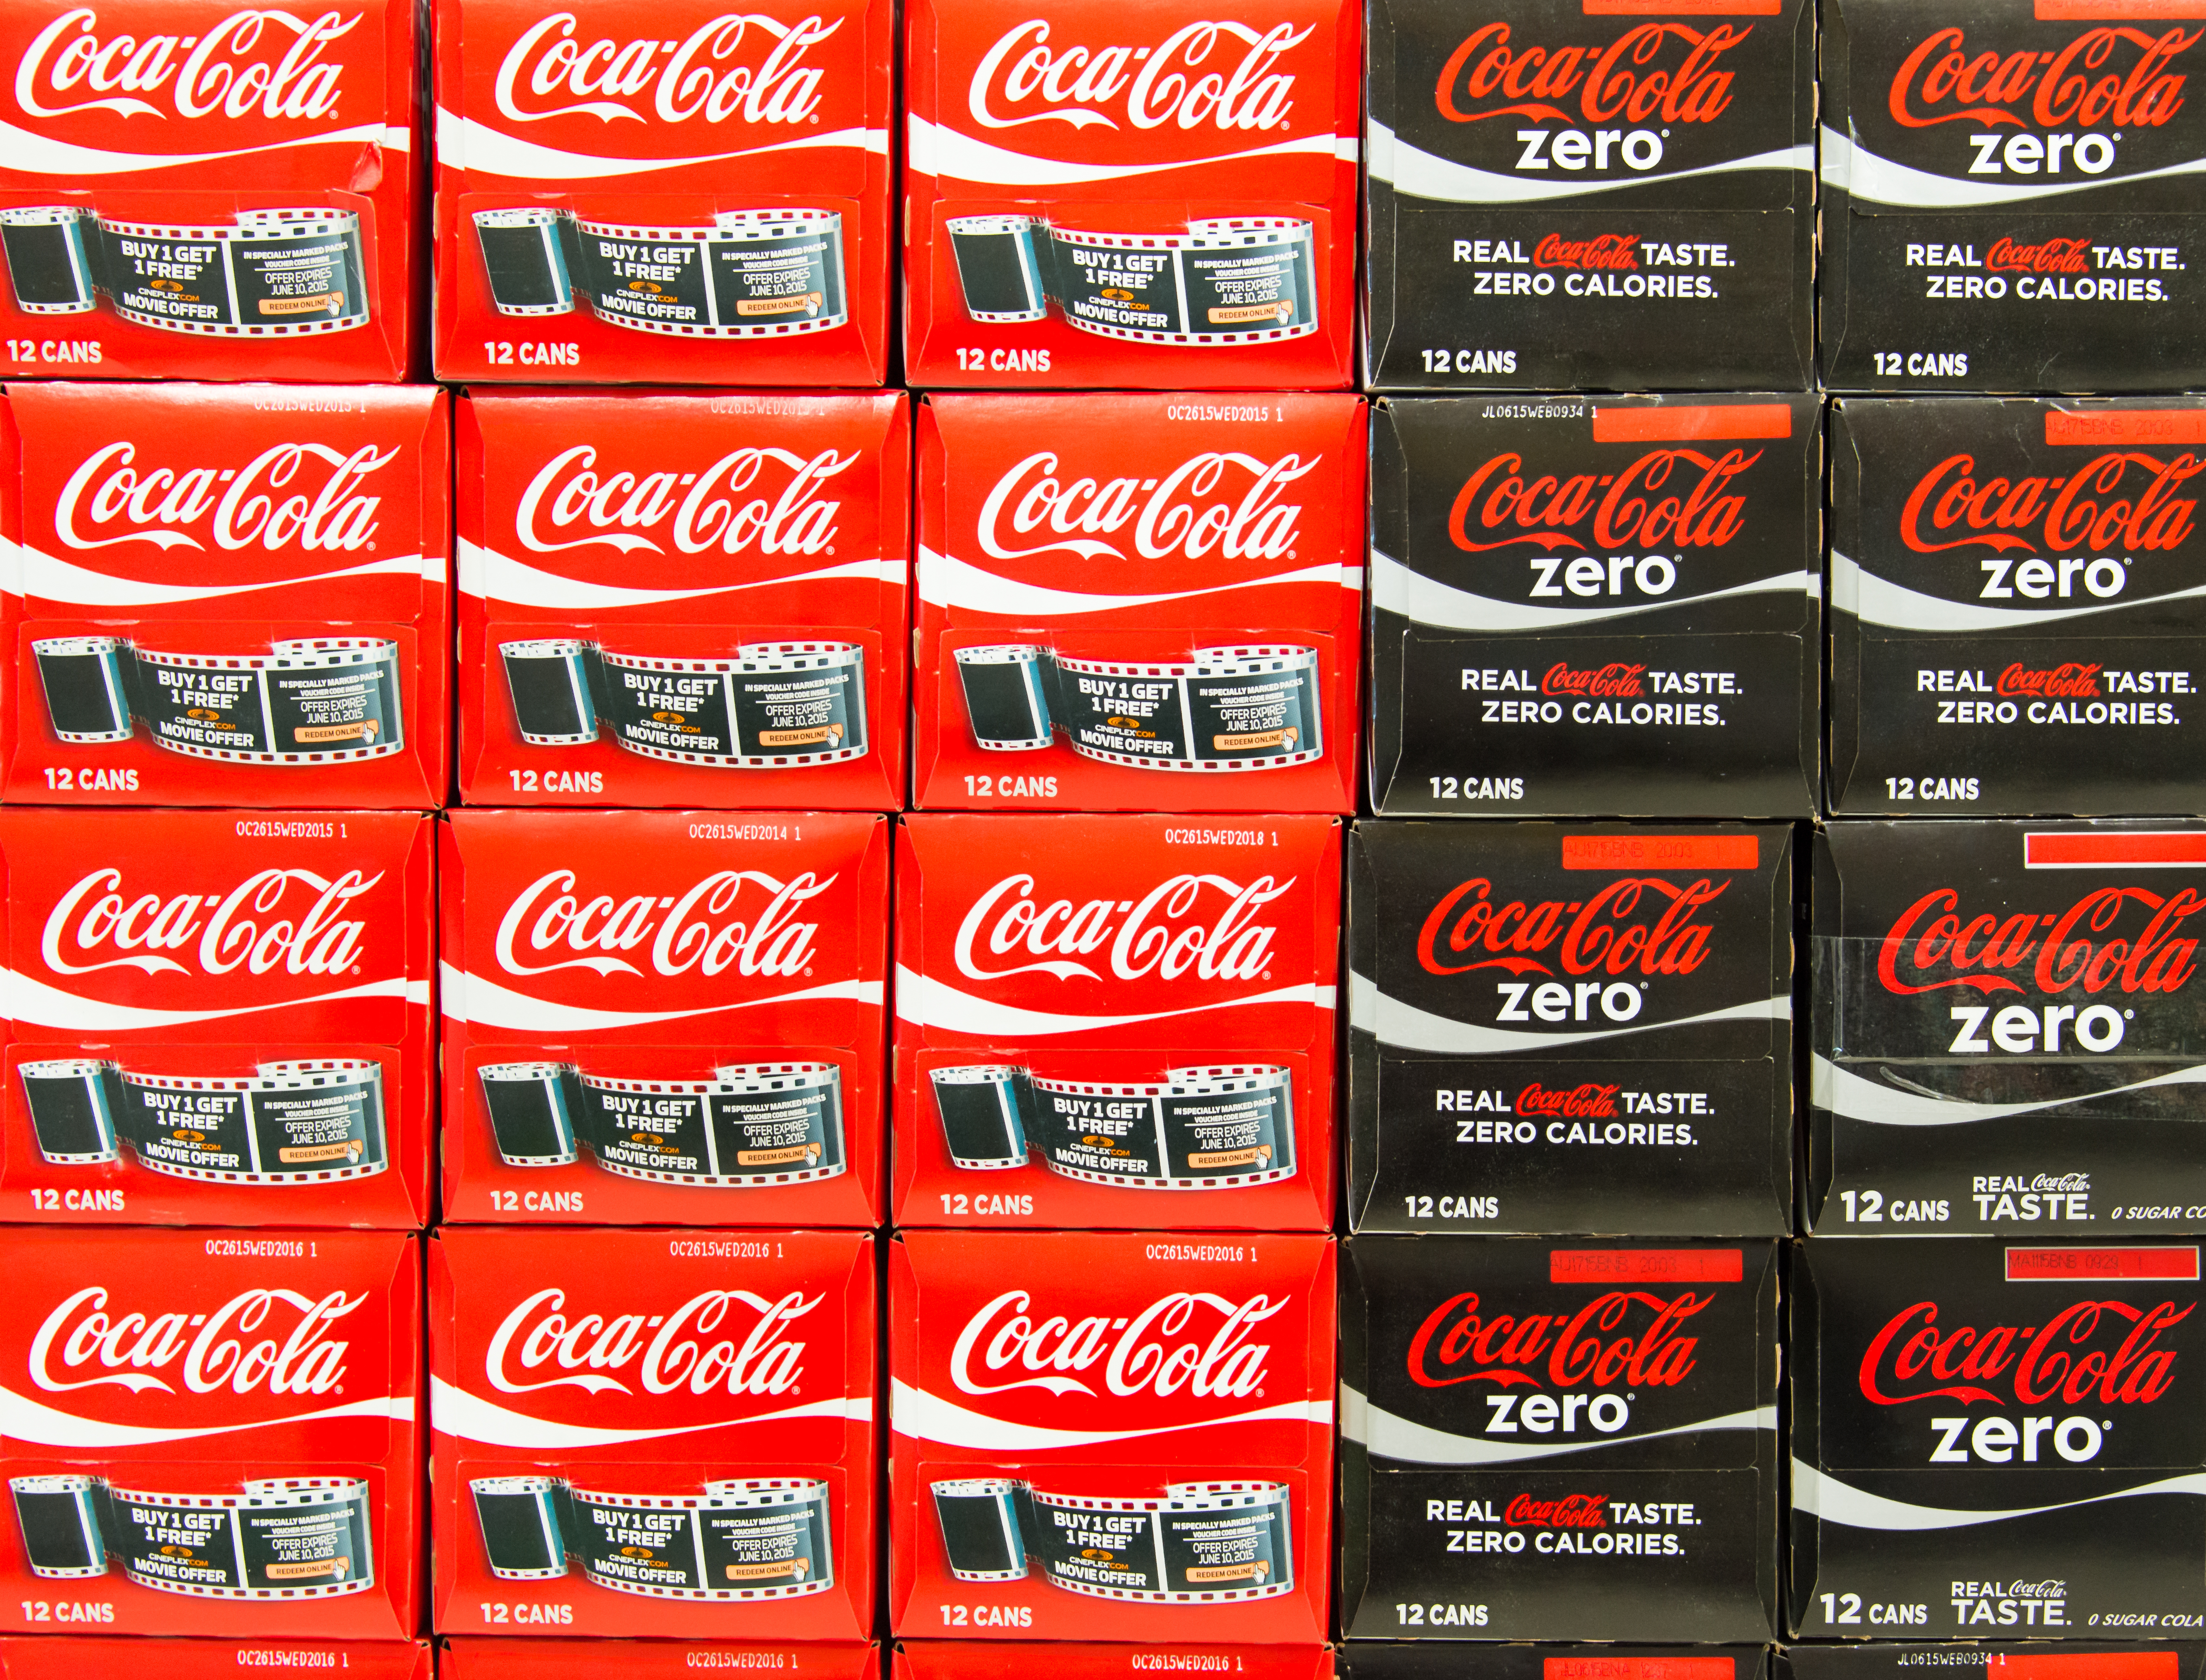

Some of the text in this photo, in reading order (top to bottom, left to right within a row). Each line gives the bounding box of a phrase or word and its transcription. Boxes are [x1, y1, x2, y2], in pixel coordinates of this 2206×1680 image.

[16, 7, 363, 119] Coca-Cola
[496, 13, 844, 124] Coca-Cola
[1435, 22, 1754, 124] Coca-Cola
[969, 20, 1316, 130] Coca-Cola
[1888, 27, 2205, 129] Coca-Cola
[1515, 130, 1664, 169] zero
[1969, 134, 2114, 173] zero
[1454, 241, 1529, 262] REAL
[1641, 243, 1735, 266] TASTE.
[1474, 273, 1717, 298] ZERO CALORIES.
[7, 340, 101, 363] 12 CANS
[957, 348, 1050, 371] 12 CANS
[1874, 353, 1967, 376] 12 CANS
[1276, 406, 1283, 422] 1
[1592, 406, 1598, 418] 1
[56, 442, 400, 551] Coca-Cola
[516, 445, 861, 554] Coca-Cola
[978, 452, 1322, 560] Coca-Cola
[1449, 449, 1763, 552] Coca-Cola
[1900, 452, 2206, 553] Coca-Cola
[1529, 555, 1677, 596] zero
[1980, 558, 2125, 598] zero
[1079, 678, 1173, 700] BUY 1 GET
[1208, 687, 1247, 696] SPECIALLY
[1247, 683, 1279, 694] MARKED
[1280, 677, 1304, 689] PACKS
[1918, 671, 1992, 691] REAL
[2104, 671, 2196, 693] TASTE.
[1092, 697, 1101, 711] 1
[1265, 691, 1285, 701] INSIDE
[1220, 703, 1286, 720] OFFER EXPIRES
[1227, 720, 1249, 731] JUNE
[1263, 715, 1283, 729] 2015
[1938, 702, 2179, 724] ZERO CALORIES.
[1080, 729, 1173, 754] MOVIE OFFER
[1255, 735, 1280, 743] ONLINE
[510, 770, 602, 793] 12 CANS
[1430, 777, 1523, 799] 12 CANS
[340, 823, 347, 838] 1
[795, 826, 801, 840] 1
[1272, 831, 1279, 847] 1
[42, 868, 384, 975] Coca-Cola
[496, 870, 838, 977] Coca-Cola
[955, 874, 1296, 981] Coca-Cola
[1417, 878, 1731, 976] Coca-Cola
[1878, 887, 2206, 995] Coca-Cola
[1496, 983, 1642, 1021] zero
[1949, 1005, 2123, 1053] zero
[144, 1092, 238, 1113] BUY 1 GET
[273, 1100, 311, 1109] SPECIALLY
[312, 1096, 343, 1107] MARKED
[344, 1090, 368, 1102] PACKS
[1437, 1090, 1511, 1111] REAL
[1622, 1093, 1714, 1114] TASTE.
[157, 1110, 167, 1125] 1
[285, 1109, 313, 1118] VOUCHER
[330, 1105, 349, 1114] INSIDE
[286, 1116, 351, 1133] OFFER EXPIRES
[292, 1133, 313, 1144] JUNE
[328, 1128, 348, 1141] 2015
[1457, 1121, 1697, 1145] ZERO CALORIES.
[146, 1142, 239, 1167] MOVIE OFFER
[320, 1147, 345, 1156] ONLINE
[1974, 1176, 2029, 1192] REAL
[940, 1194, 1033, 1215] 12 CANS
[1841, 1191, 1949, 1222] 12 CANS
[1973, 1194, 2095, 1220] TASTE.
[2126, 1206, 2181, 1219] SUGAR
[2186, 1206, 2206, 1218] CO
[311, 1242, 317, 1257] 1
[777, 1243, 783, 1258] 1
[1251, 1247, 1257, 1262] 1
[30, 1287, 368, 1394] Coca-Cola
[486, 1289, 825, 1395] Coca-Cola
[951, 1290, 1290, 1397] Coca-Cola
[1407, 1292, 1715, 1388] Coca-Cola
[1860, 1301, 2197, 1406] Coca-Cola
[1486, 1394, 1629, 1432] zero
[1930, 1417, 2102, 1462] zero
[1952, 1582, 2007, 1597] REAL
[481, 1603, 572, 1624] 12 CANS
[1397, 1604, 1488, 1626] 12 CANS
[1821, 1594, 1927, 1624] 12 CANS
[1951, 1600, 2071, 1625] TASTE.
[2103, 1615, 2157, 1626] SUGAR
[2162, 1615, 2203, 1626] COLA
[343, 1653, 349, 1668] 1
[792, 1654, 798, 1669] 1
[1237, 1656, 1243, 1671] 1
